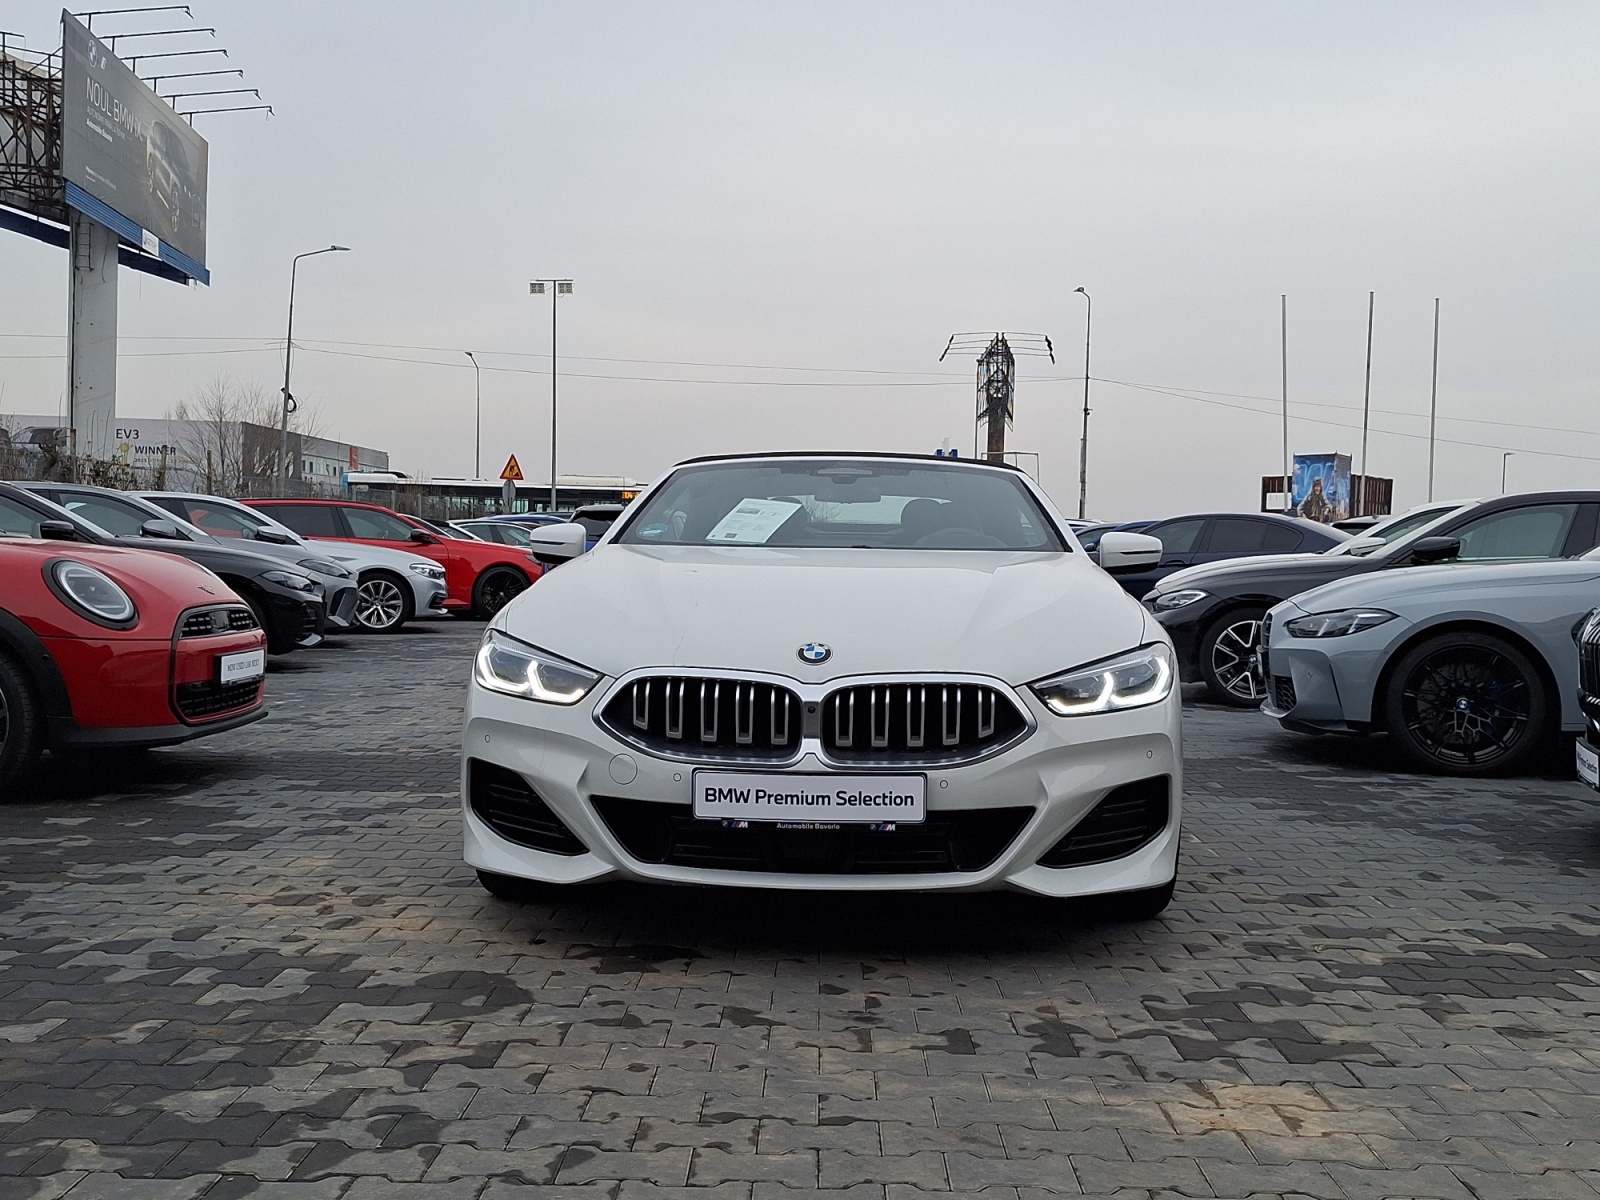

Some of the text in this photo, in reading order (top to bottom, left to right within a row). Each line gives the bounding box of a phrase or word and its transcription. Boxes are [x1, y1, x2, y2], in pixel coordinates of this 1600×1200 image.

[86, 76, 112, 116] NOUL
[113, 98, 134, 133] BMW
[116, 429, 140, 439] EV3
[134, 445, 177, 455] WINNER
[704, 787, 915, 807] BMW Premium Selection
